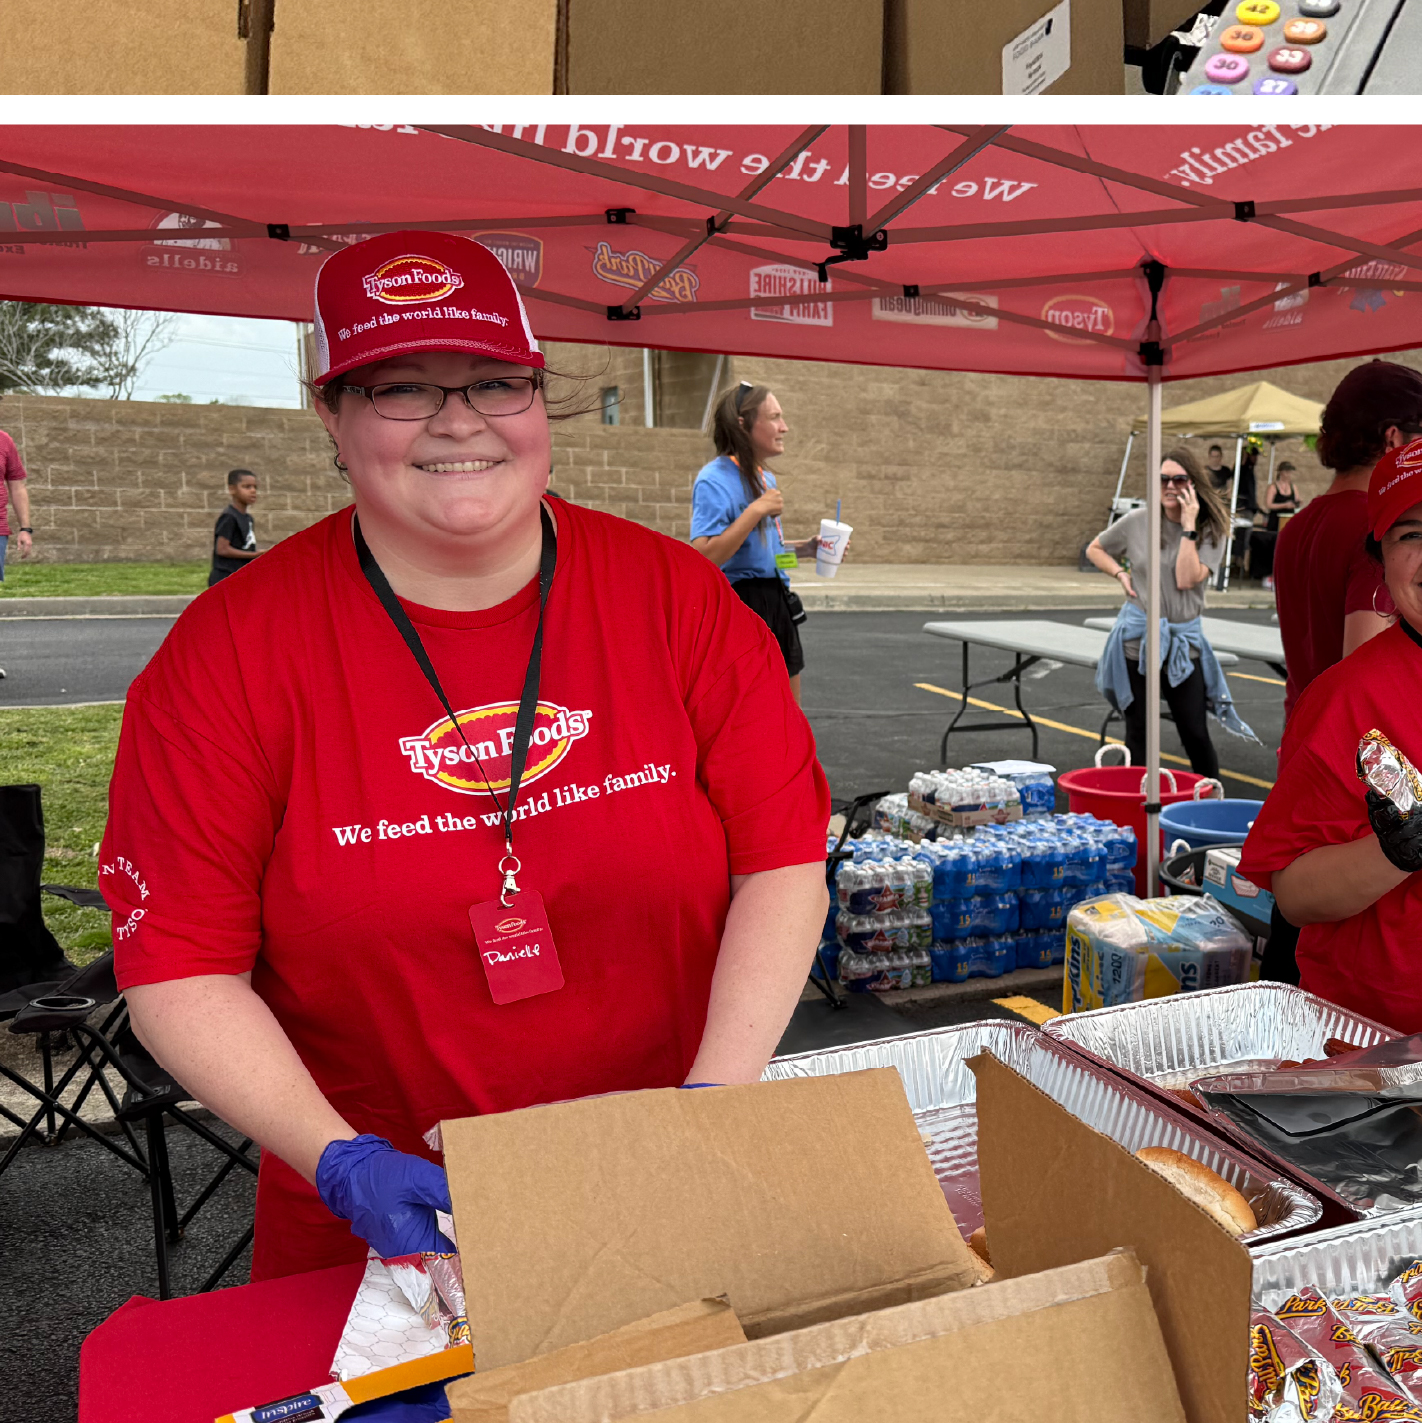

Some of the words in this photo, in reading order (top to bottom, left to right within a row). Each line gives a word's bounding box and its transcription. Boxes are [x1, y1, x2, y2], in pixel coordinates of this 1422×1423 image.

[1245, 4, 1270, 14] 42
[1231, 31, 1254, 41] 36
[1277, 49, 1303, 62] 33
[1214, 58, 1239, 70] 30
[1260, 80, 1288, 94] 27
[368, 276, 411, 293] Tyson
[411, 269, 460, 285] Foods
[337, 327, 351, 342] We
[352, 316, 378, 336] feed
[379, 313, 400, 328] the
[402, 306, 443, 321] world
[444, 306, 470, 320] like
[404, 740, 497, 775] Tyson
[497, 711, 584, 756] Fods
[331, 824, 372, 847] We
[376, 814, 433, 841] feed
[435, 812, 477, 834] the
[480, 792, 552, 828] world
[553, 782, 601, 808] like
[602, 761, 678, 796] family.
[116, 856, 151, 901] TEAM
[1052, 865, 1064, 878] 15
[116, 908, 149, 941] TYSO
[959, 915, 971, 926] 15
[1040, 949, 1052, 961] 15
[957, 963, 969, 974] 15
[1111, 951, 1123, 984] 1200
[1282, 1297, 1327, 1316] Park
[260, 1397, 312, 1420] Inspire
